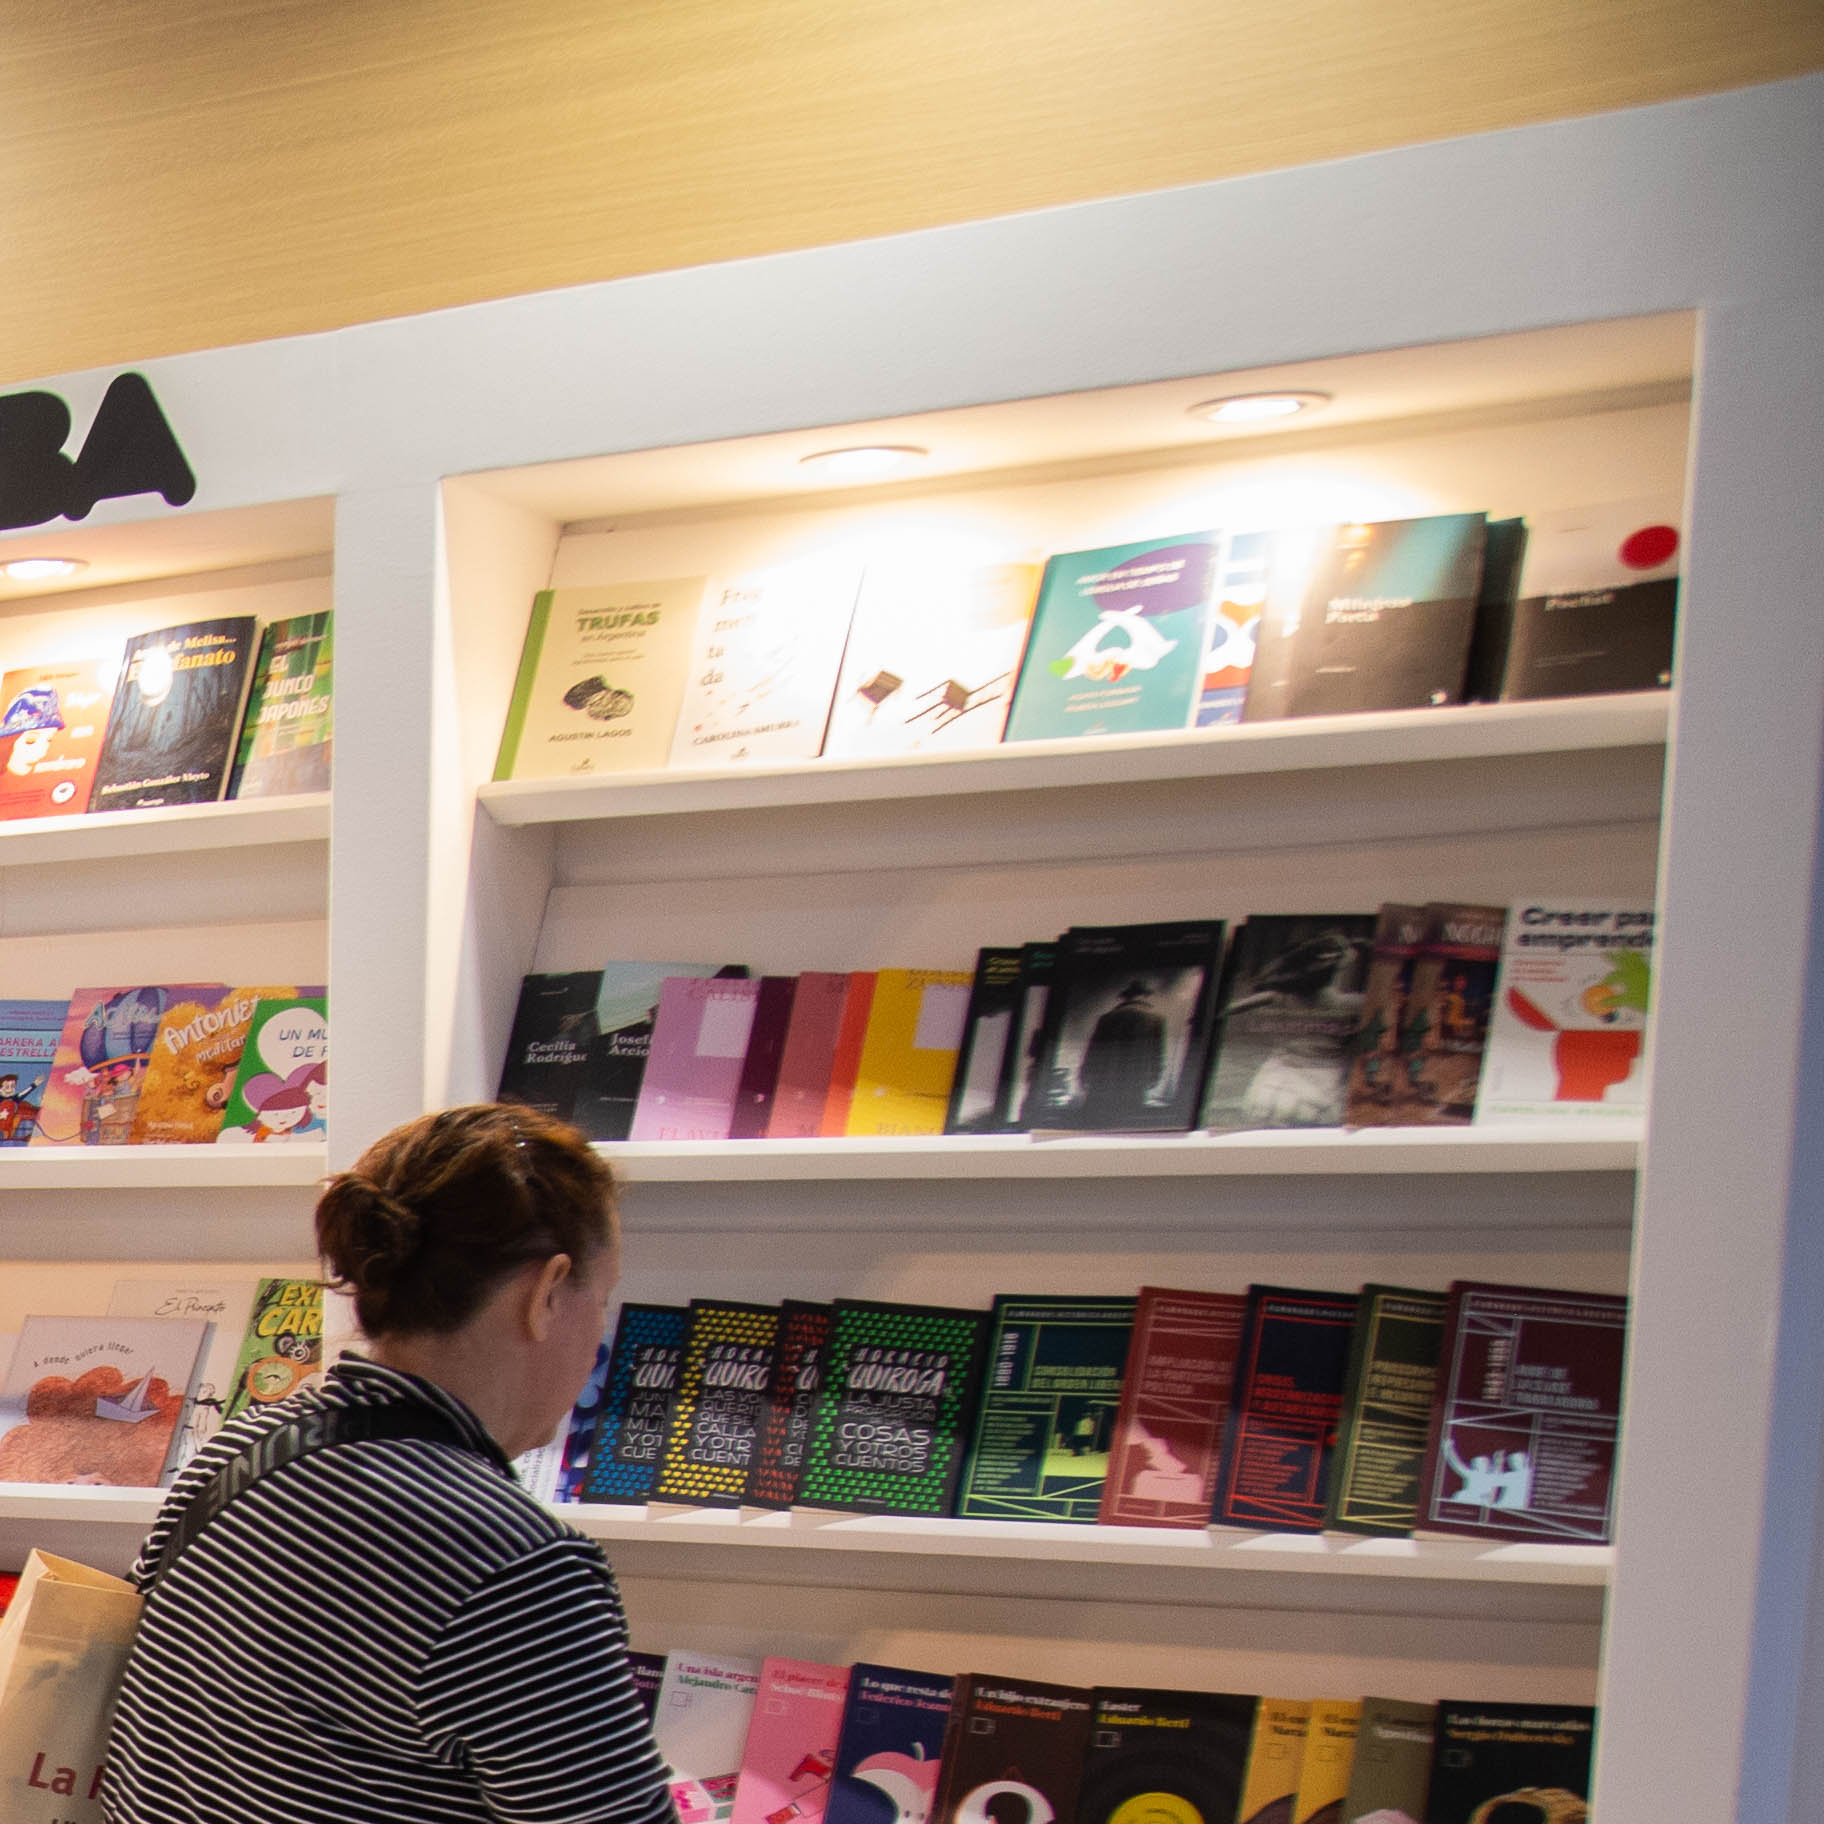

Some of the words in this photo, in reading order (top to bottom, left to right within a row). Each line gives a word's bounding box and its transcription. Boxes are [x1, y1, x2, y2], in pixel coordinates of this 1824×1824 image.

[576, 611, 661, 632] TRUFAS
[1522, 906, 1612, 927] Crear
[280, 1028, 302, 1043] UN
[293, 1045, 316, 1059] DE
[529, 1040, 577, 1054] Cecilia
[855, 1349, 949, 1368] HORACIO
[848, 1364, 948, 1397] QUIROGA
[696, 1435, 710, 1450] Y
[840, 1423, 931, 1446] COSAS
[839, 1439, 853, 1452] Y
[858, 1441, 928, 1460] OTROS
[836, 1453, 926, 1473] CUENTOS
[28, 1751, 77, 1798] La
